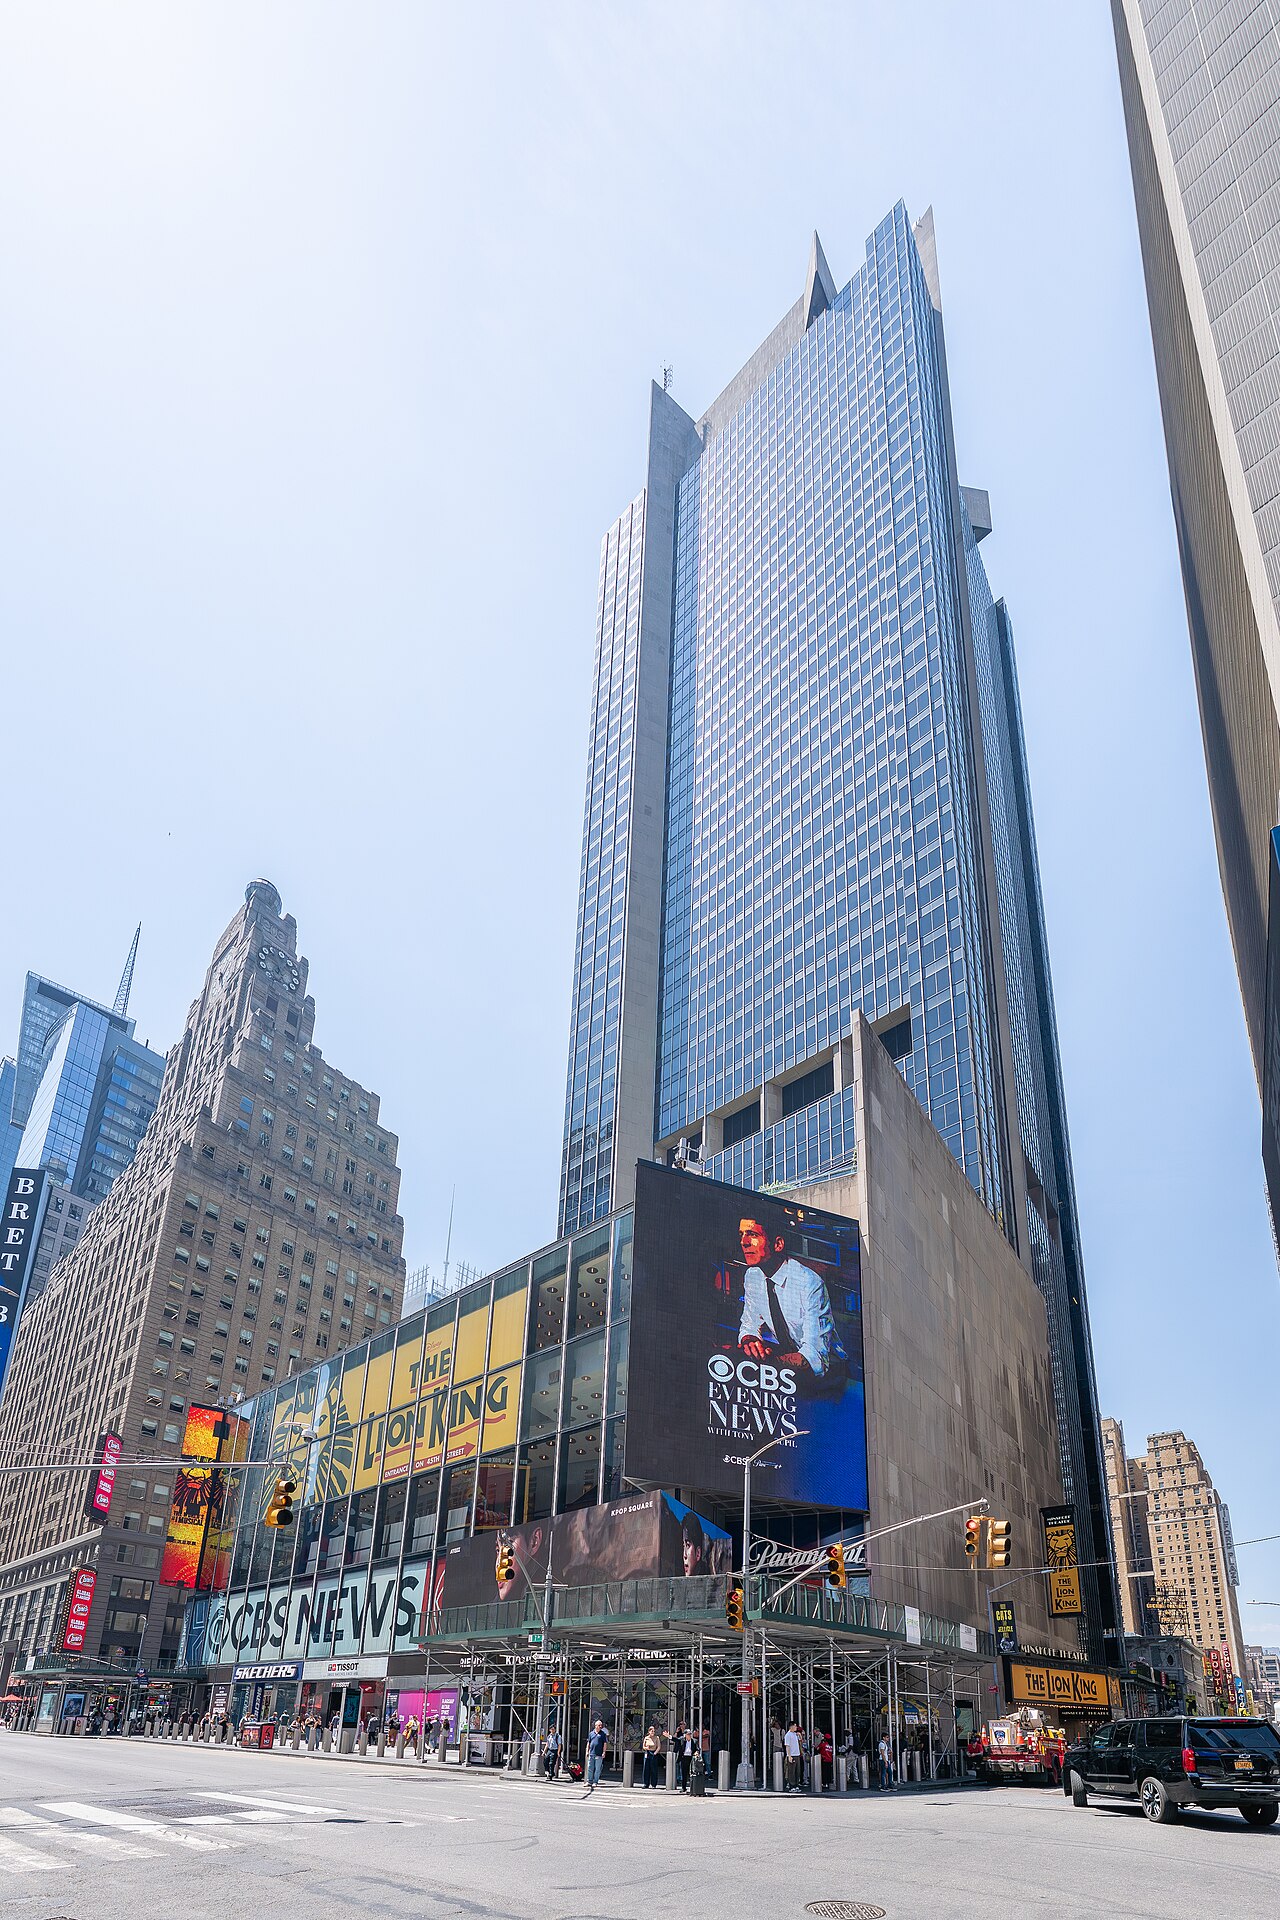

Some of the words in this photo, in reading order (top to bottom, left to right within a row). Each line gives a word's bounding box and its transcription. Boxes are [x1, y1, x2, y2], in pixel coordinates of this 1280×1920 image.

[1, 1177, 35, 1271] BRET
[409, 1348, 450, 1388] THE
[736, 1361, 797, 1394] CBS
[708, 1381, 797, 1413] EVENING
[363, 1405, 426, 1471] LION
[428, 1376, 508, 1449] KING
[707, 1427, 730, 1436] WITH
[732, 1431, 755, 1440] TONY
[709, 1400, 797, 1438] NEWS
[384, 1465, 408, 1478] ENTRANCE
[415, 1460, 424, 1469] ON
[426, 1456, 440, 1465] 45TH
[446, 1448, 465, 1459] STREET
[730, 1456, 747, 1465] CBS
[611, 1507, 627, 1516] KPOP
[628, 1501, 653, 1512] SQUARE
[1056, 1588, 1074, 1597] LION
[1057, 1577, 1071, 1585] THE
[230, 1596, 291, 1650] CBS
[295, 1576, 419, 1645] NEWS
[995, 1610, 1012, 1621] CATS
[1055, 1599, 1078, 1610] KING
[234, 1664, 297, 1679] SKECHERS
[337, 1662, 359, 1671] TISSOT
[1211, 1652, 1222, 1694] BOOTH
[1025, 1673, 1045, 1691] THE
[1045, 1669, 1070, 1699] LION
[1071, 1672, 1097, 1702] KING
